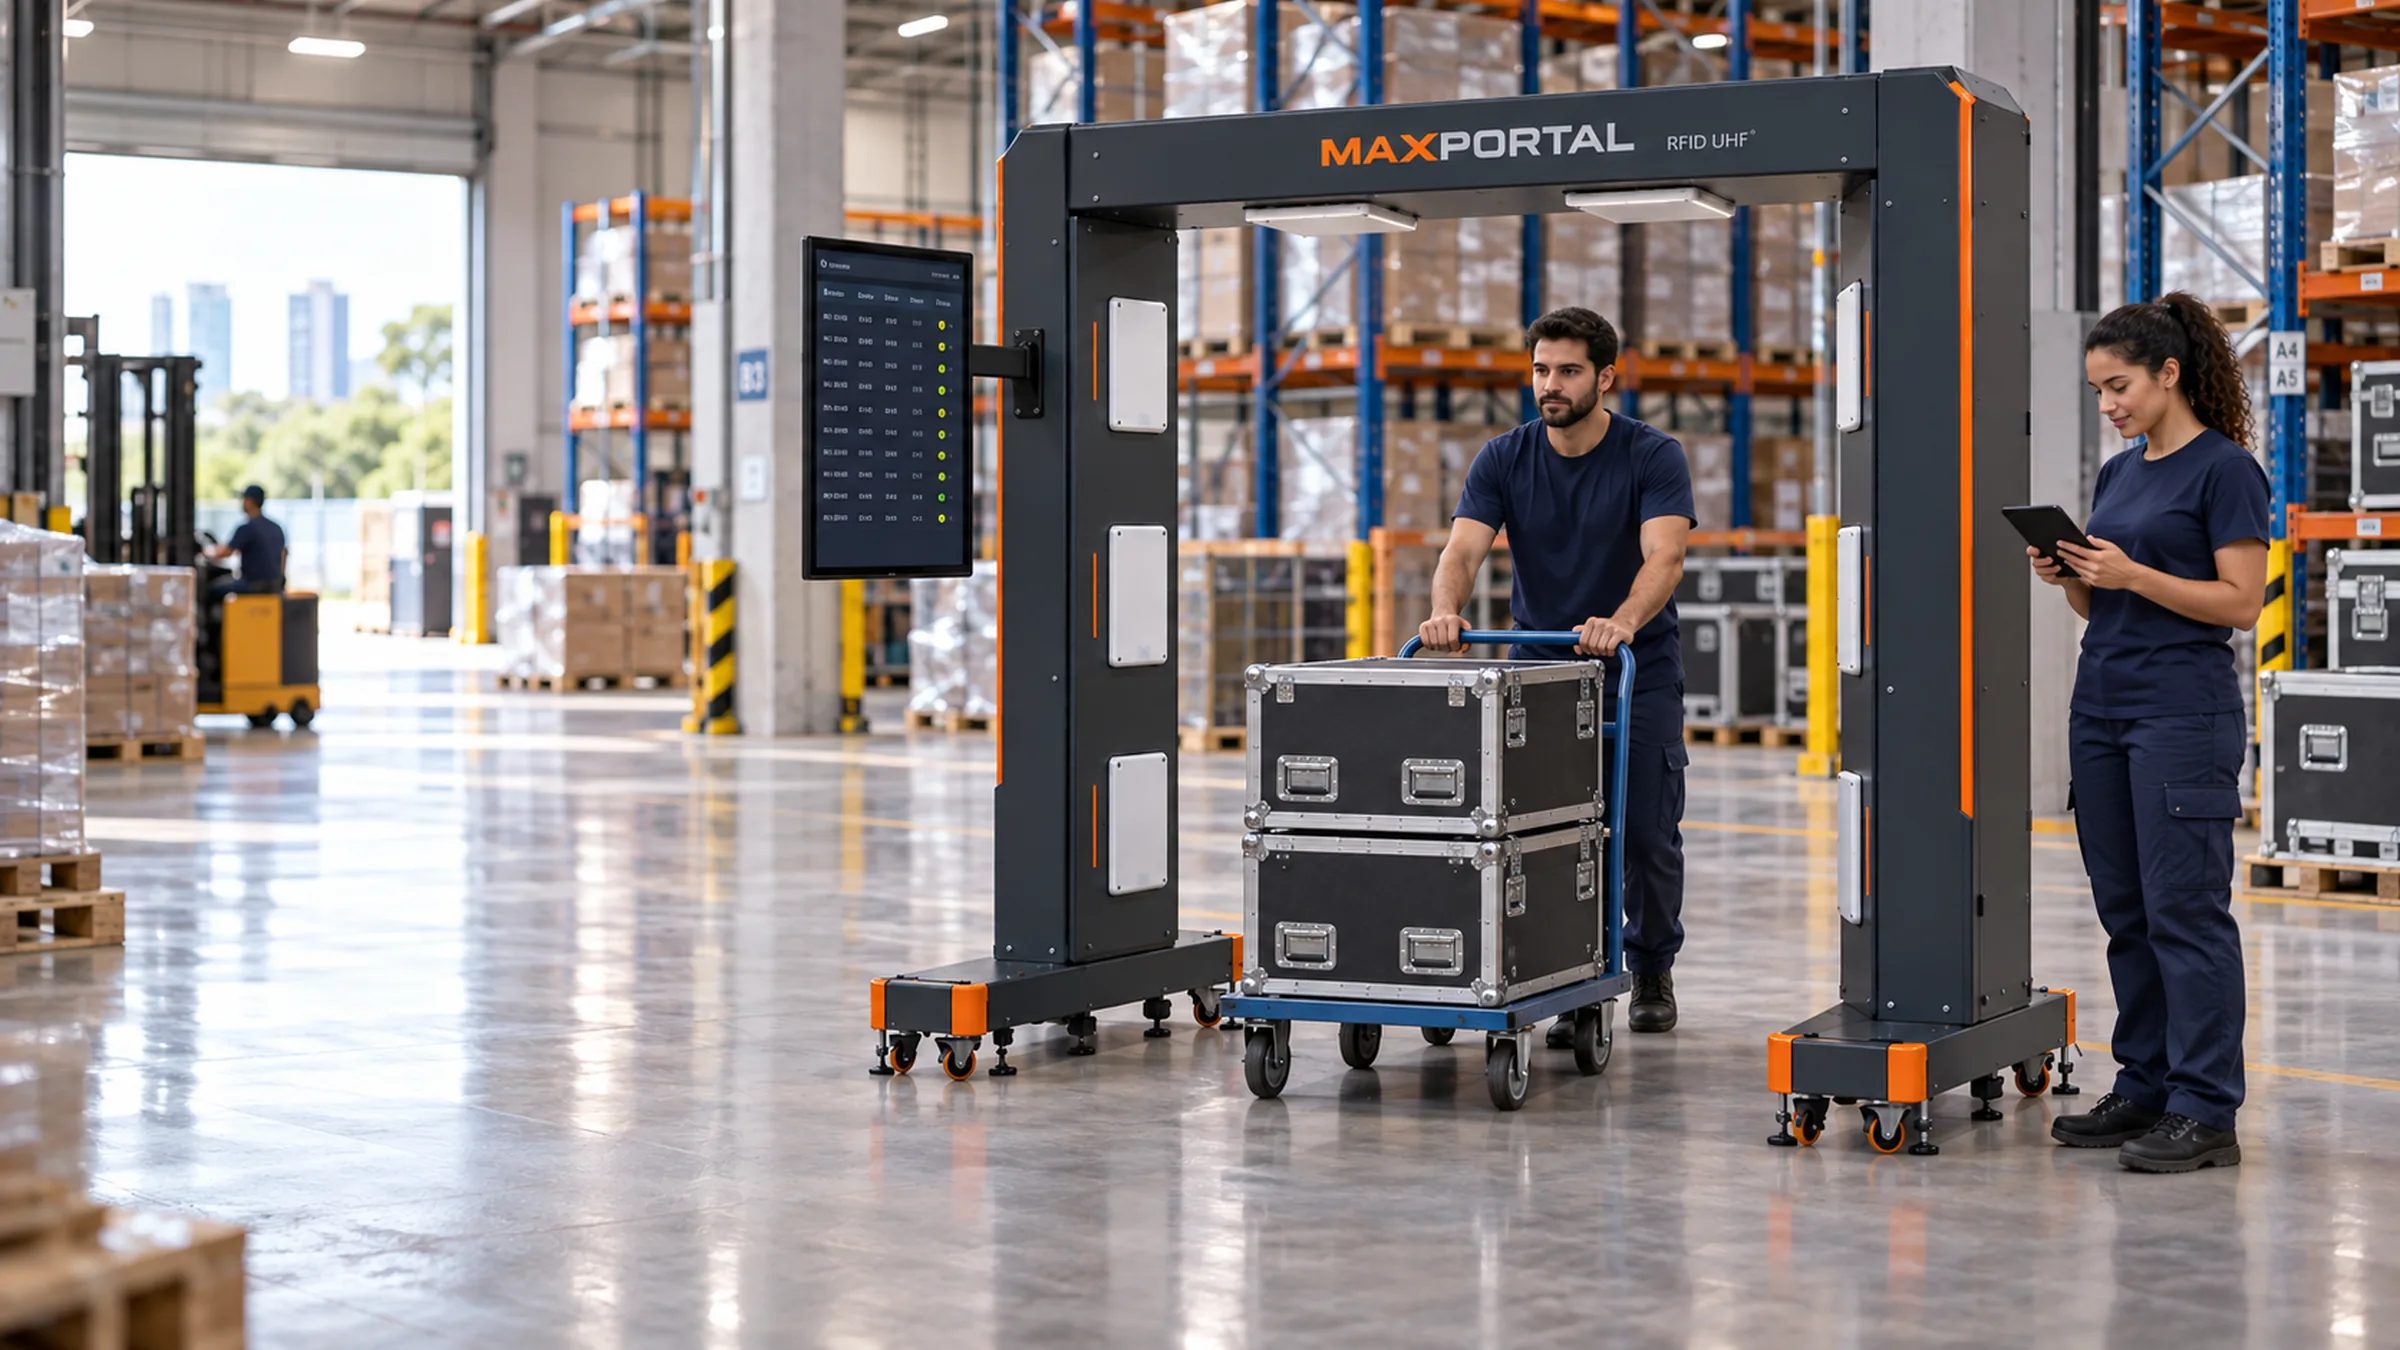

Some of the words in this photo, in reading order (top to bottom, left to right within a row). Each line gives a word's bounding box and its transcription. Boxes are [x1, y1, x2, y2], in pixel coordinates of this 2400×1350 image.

[1321, 122, 1635, 167] MAXPORTAL
[1667, 134, 1707, 151] RFID
[2276, 341, 2298, 359] A4
[2276, 368, 2298, 388] A5
